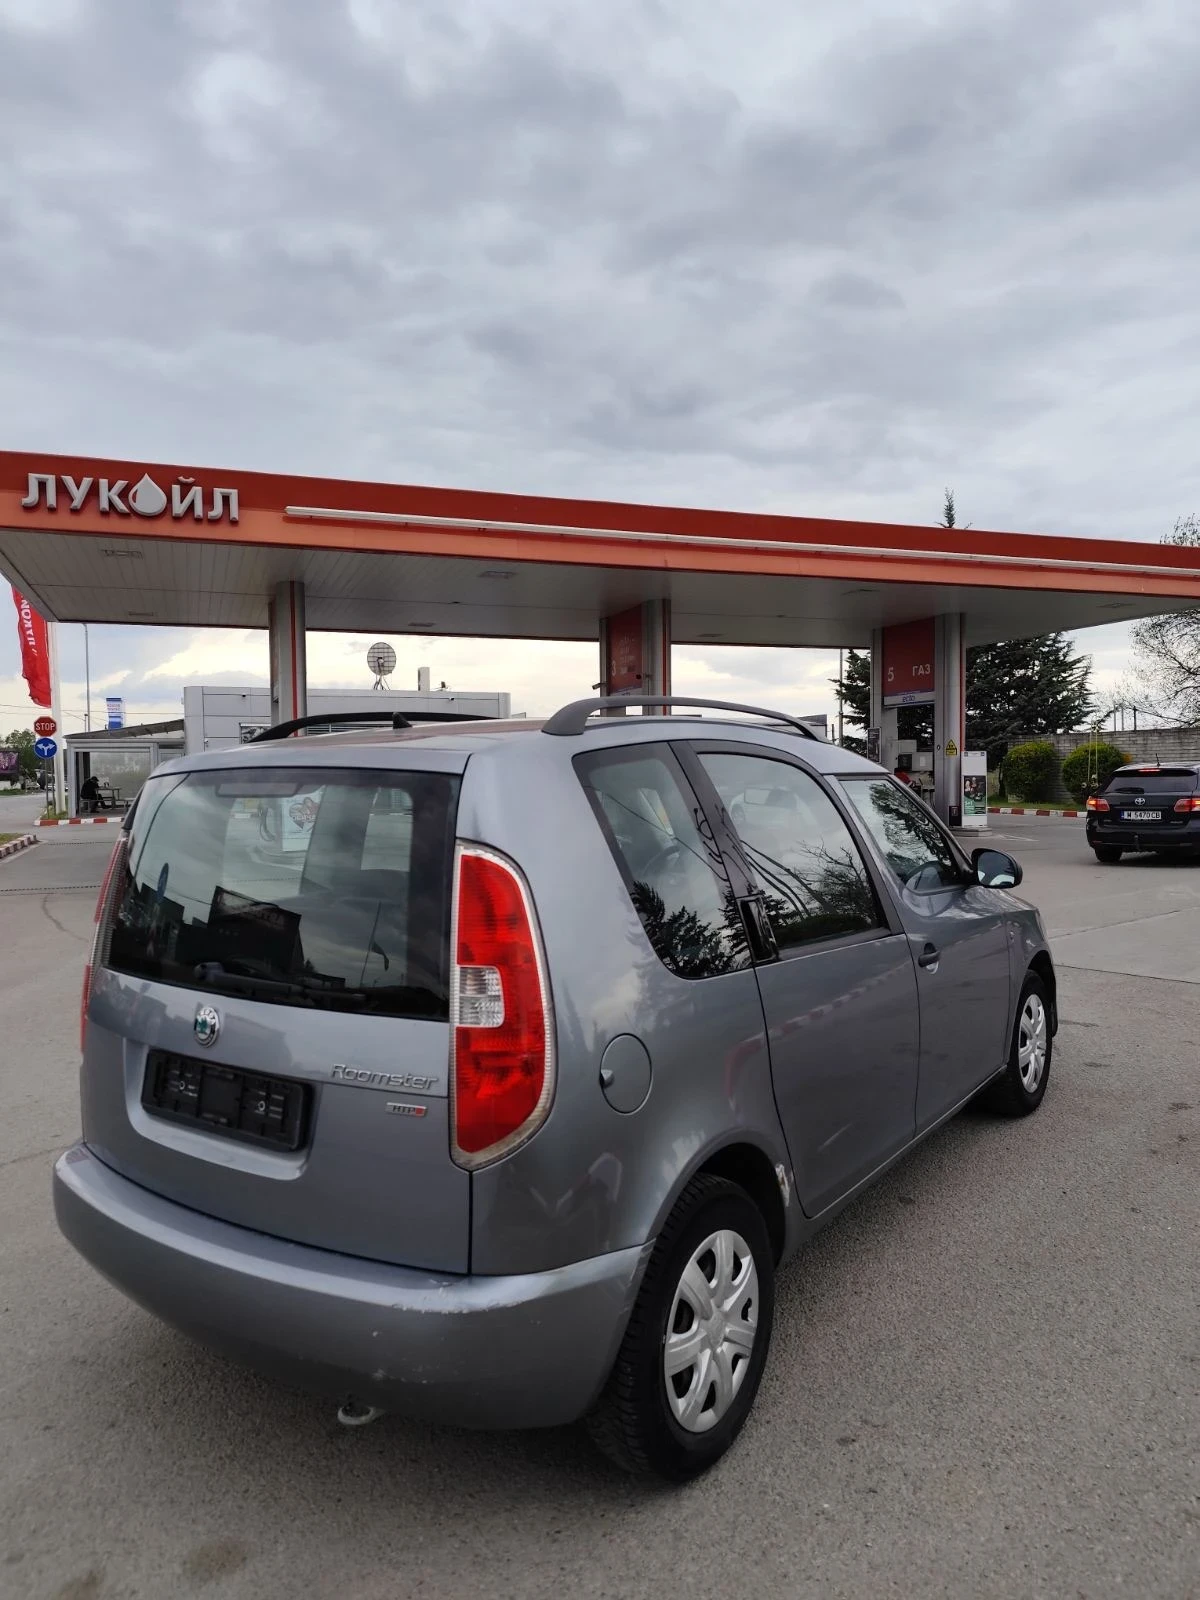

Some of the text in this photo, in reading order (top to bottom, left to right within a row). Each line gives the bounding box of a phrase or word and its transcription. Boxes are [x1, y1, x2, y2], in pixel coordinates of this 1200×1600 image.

[887, 664, 931, 682] 5 ГАЗ
[35, 722, 56, 731] STOP
[331, 1063, 439, 1090] Roomster
